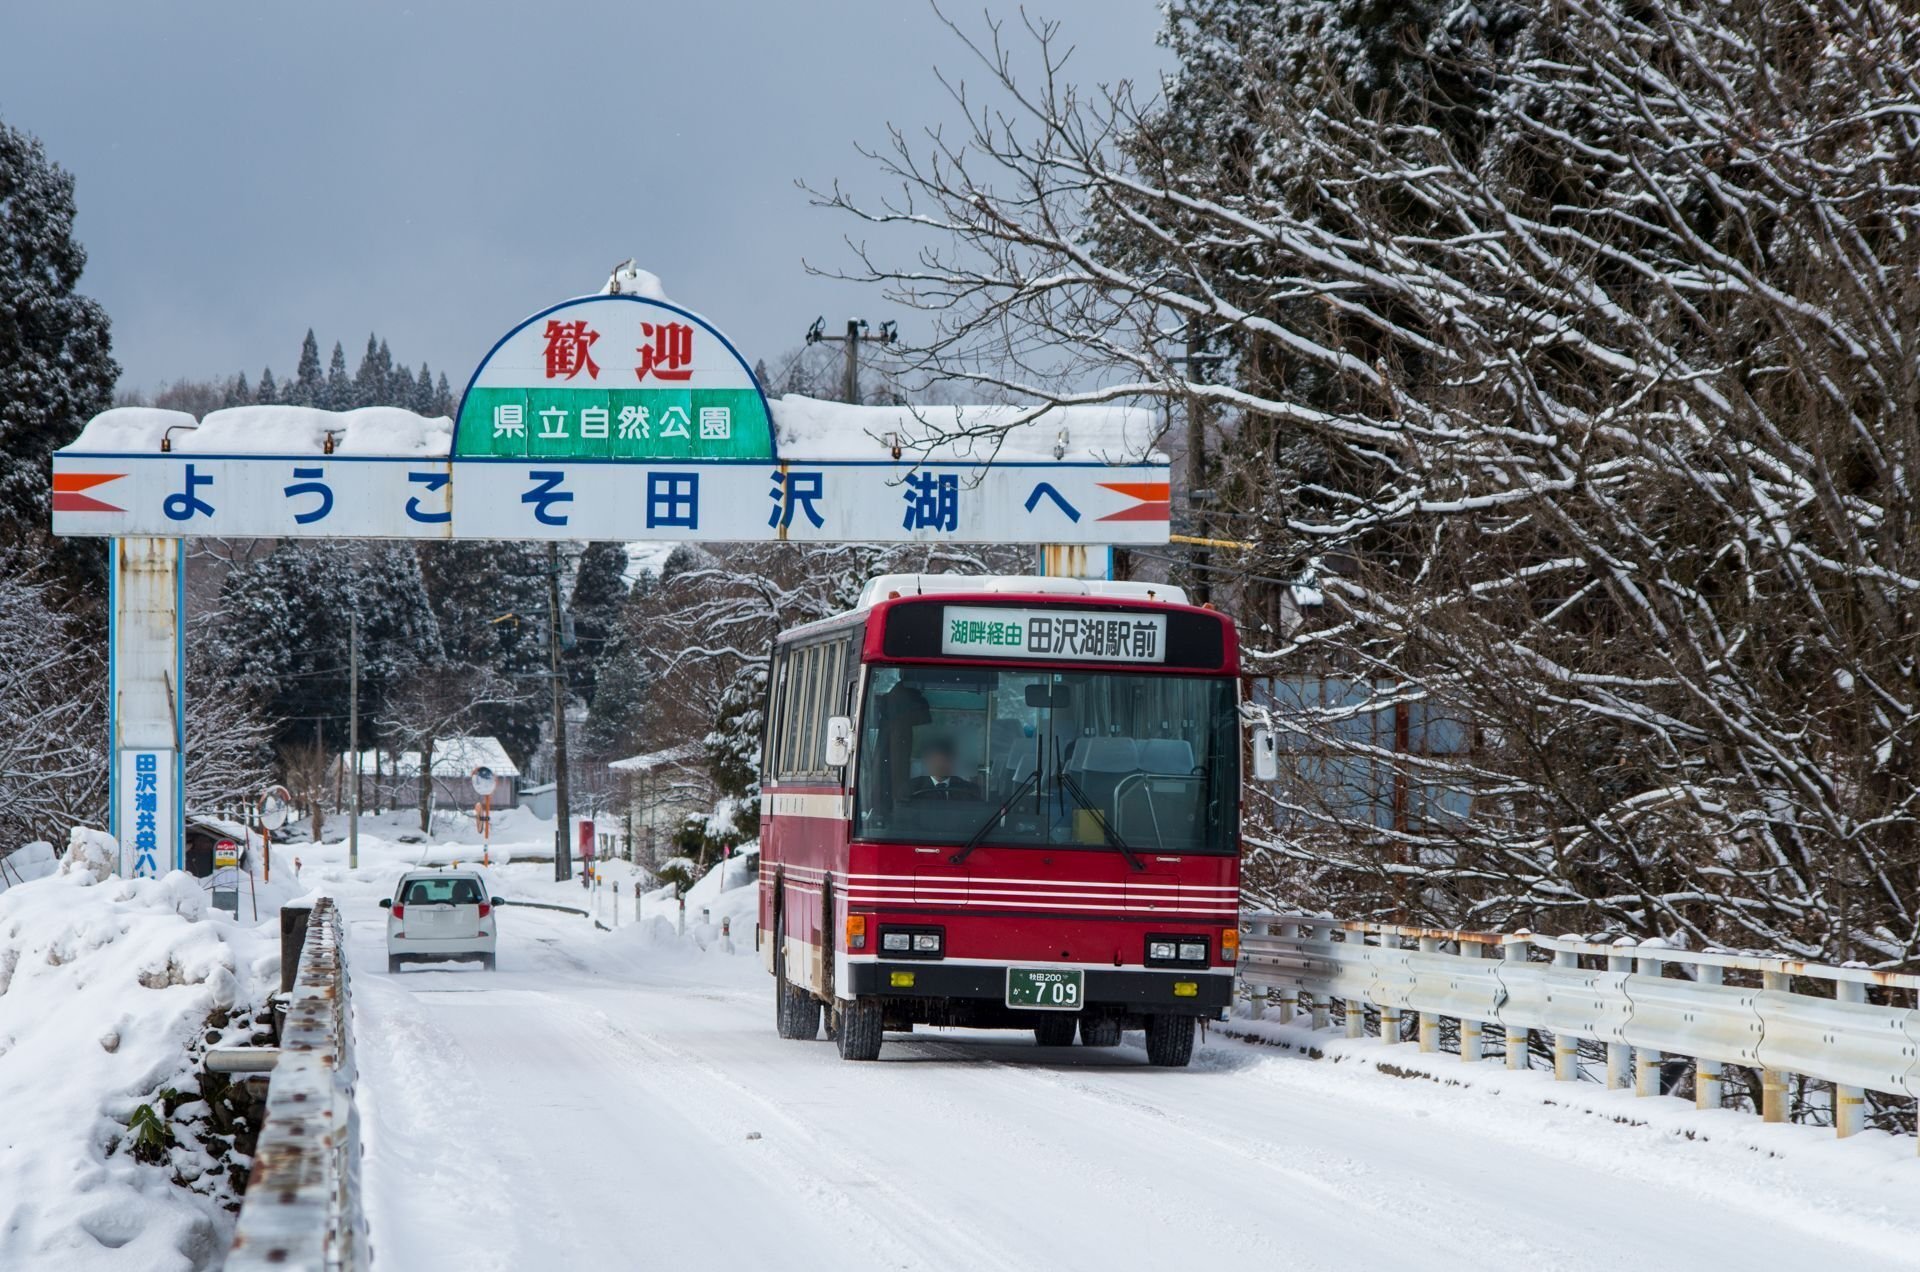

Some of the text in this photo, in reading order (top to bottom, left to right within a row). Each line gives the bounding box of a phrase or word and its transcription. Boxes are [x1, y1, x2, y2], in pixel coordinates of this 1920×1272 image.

[542, 320, 694, 382] 歓迎
[493, 404, 731, 440] 県立自然公園
[163, 464, 1081, 532] ようこそ田沢湖へ
[950, 617, 1158, 658] 湖畔経由 田沢湖駅前
